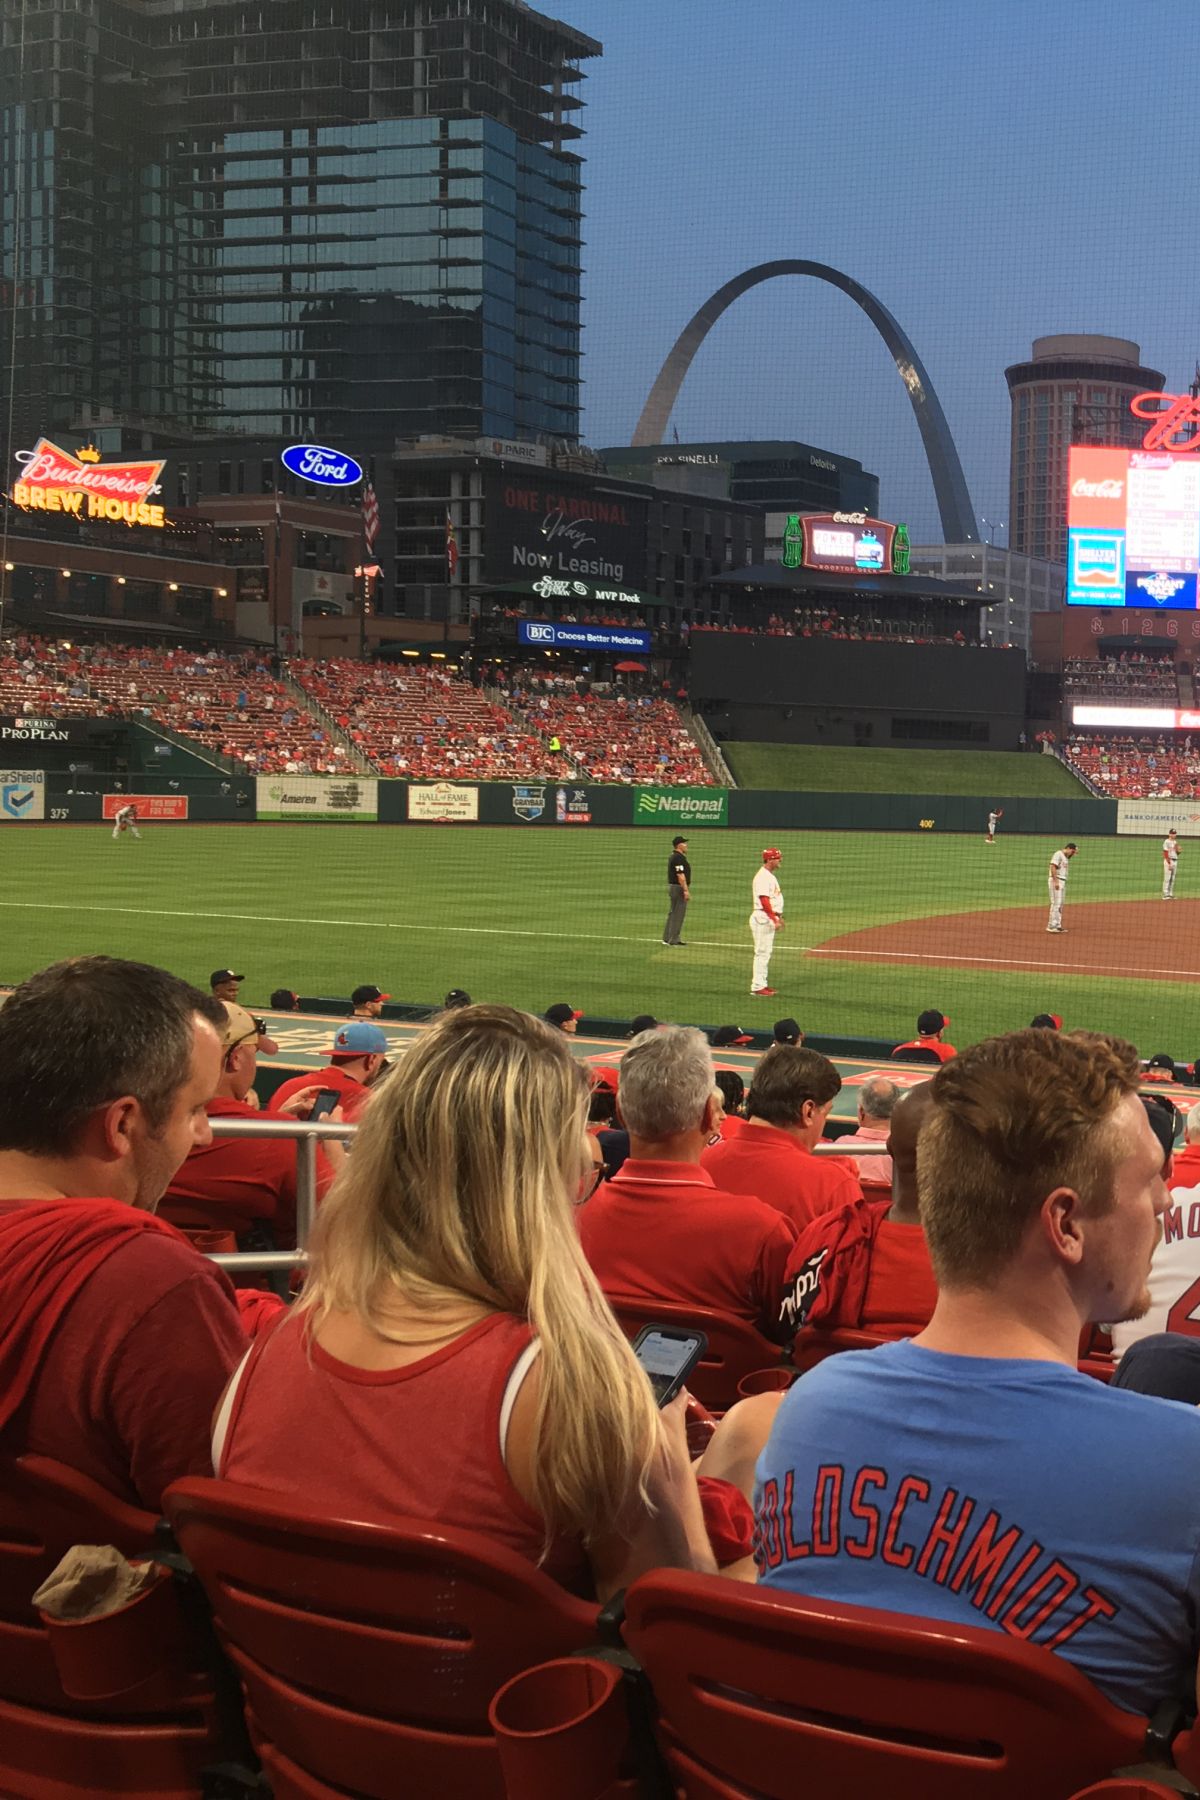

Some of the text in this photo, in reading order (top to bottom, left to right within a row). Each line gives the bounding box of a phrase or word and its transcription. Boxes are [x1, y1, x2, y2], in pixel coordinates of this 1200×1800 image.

[300, 449, 348, 479] Ford
[15, 450, 162, 495] Budweiser
[14, 483, 165, 527] BREW HOUSE
[506, 488, 630, 526] ONE CARDINAL
[513, 546, 623, 582] Now Leasing
[819, 564, 854, 573] ROOFTOP
[1185, 560, 1192, 570] 5
[1137, 578, 1185, 589] PENNANT
[595, 590, 640, 603] MVP Deck
[1147, 587, 1175, 596] RACE
[1122, 618, 1128, 635] 1
[1142, 618, 1153, 636] 2
[1166, 619, 1178, 637] 6
[530, 627, 643, 645] BJC Choose Better Medicine
[24, 719, 55, 728] PURINA
[2, 728, 69, 741] PRO PLAN
[0, 771, 42, 784] arShield
[280, 794, 316, 804] Ameren
[418, 792, 469, 802] HALL FAME
[513, 799, 544, 807] GRAYBAR
[658, 796, 724, 812] National
[681, 812, 720, 820] Car Rental
[752, 1464, 1120, 1650] OLDSCHMIDT
